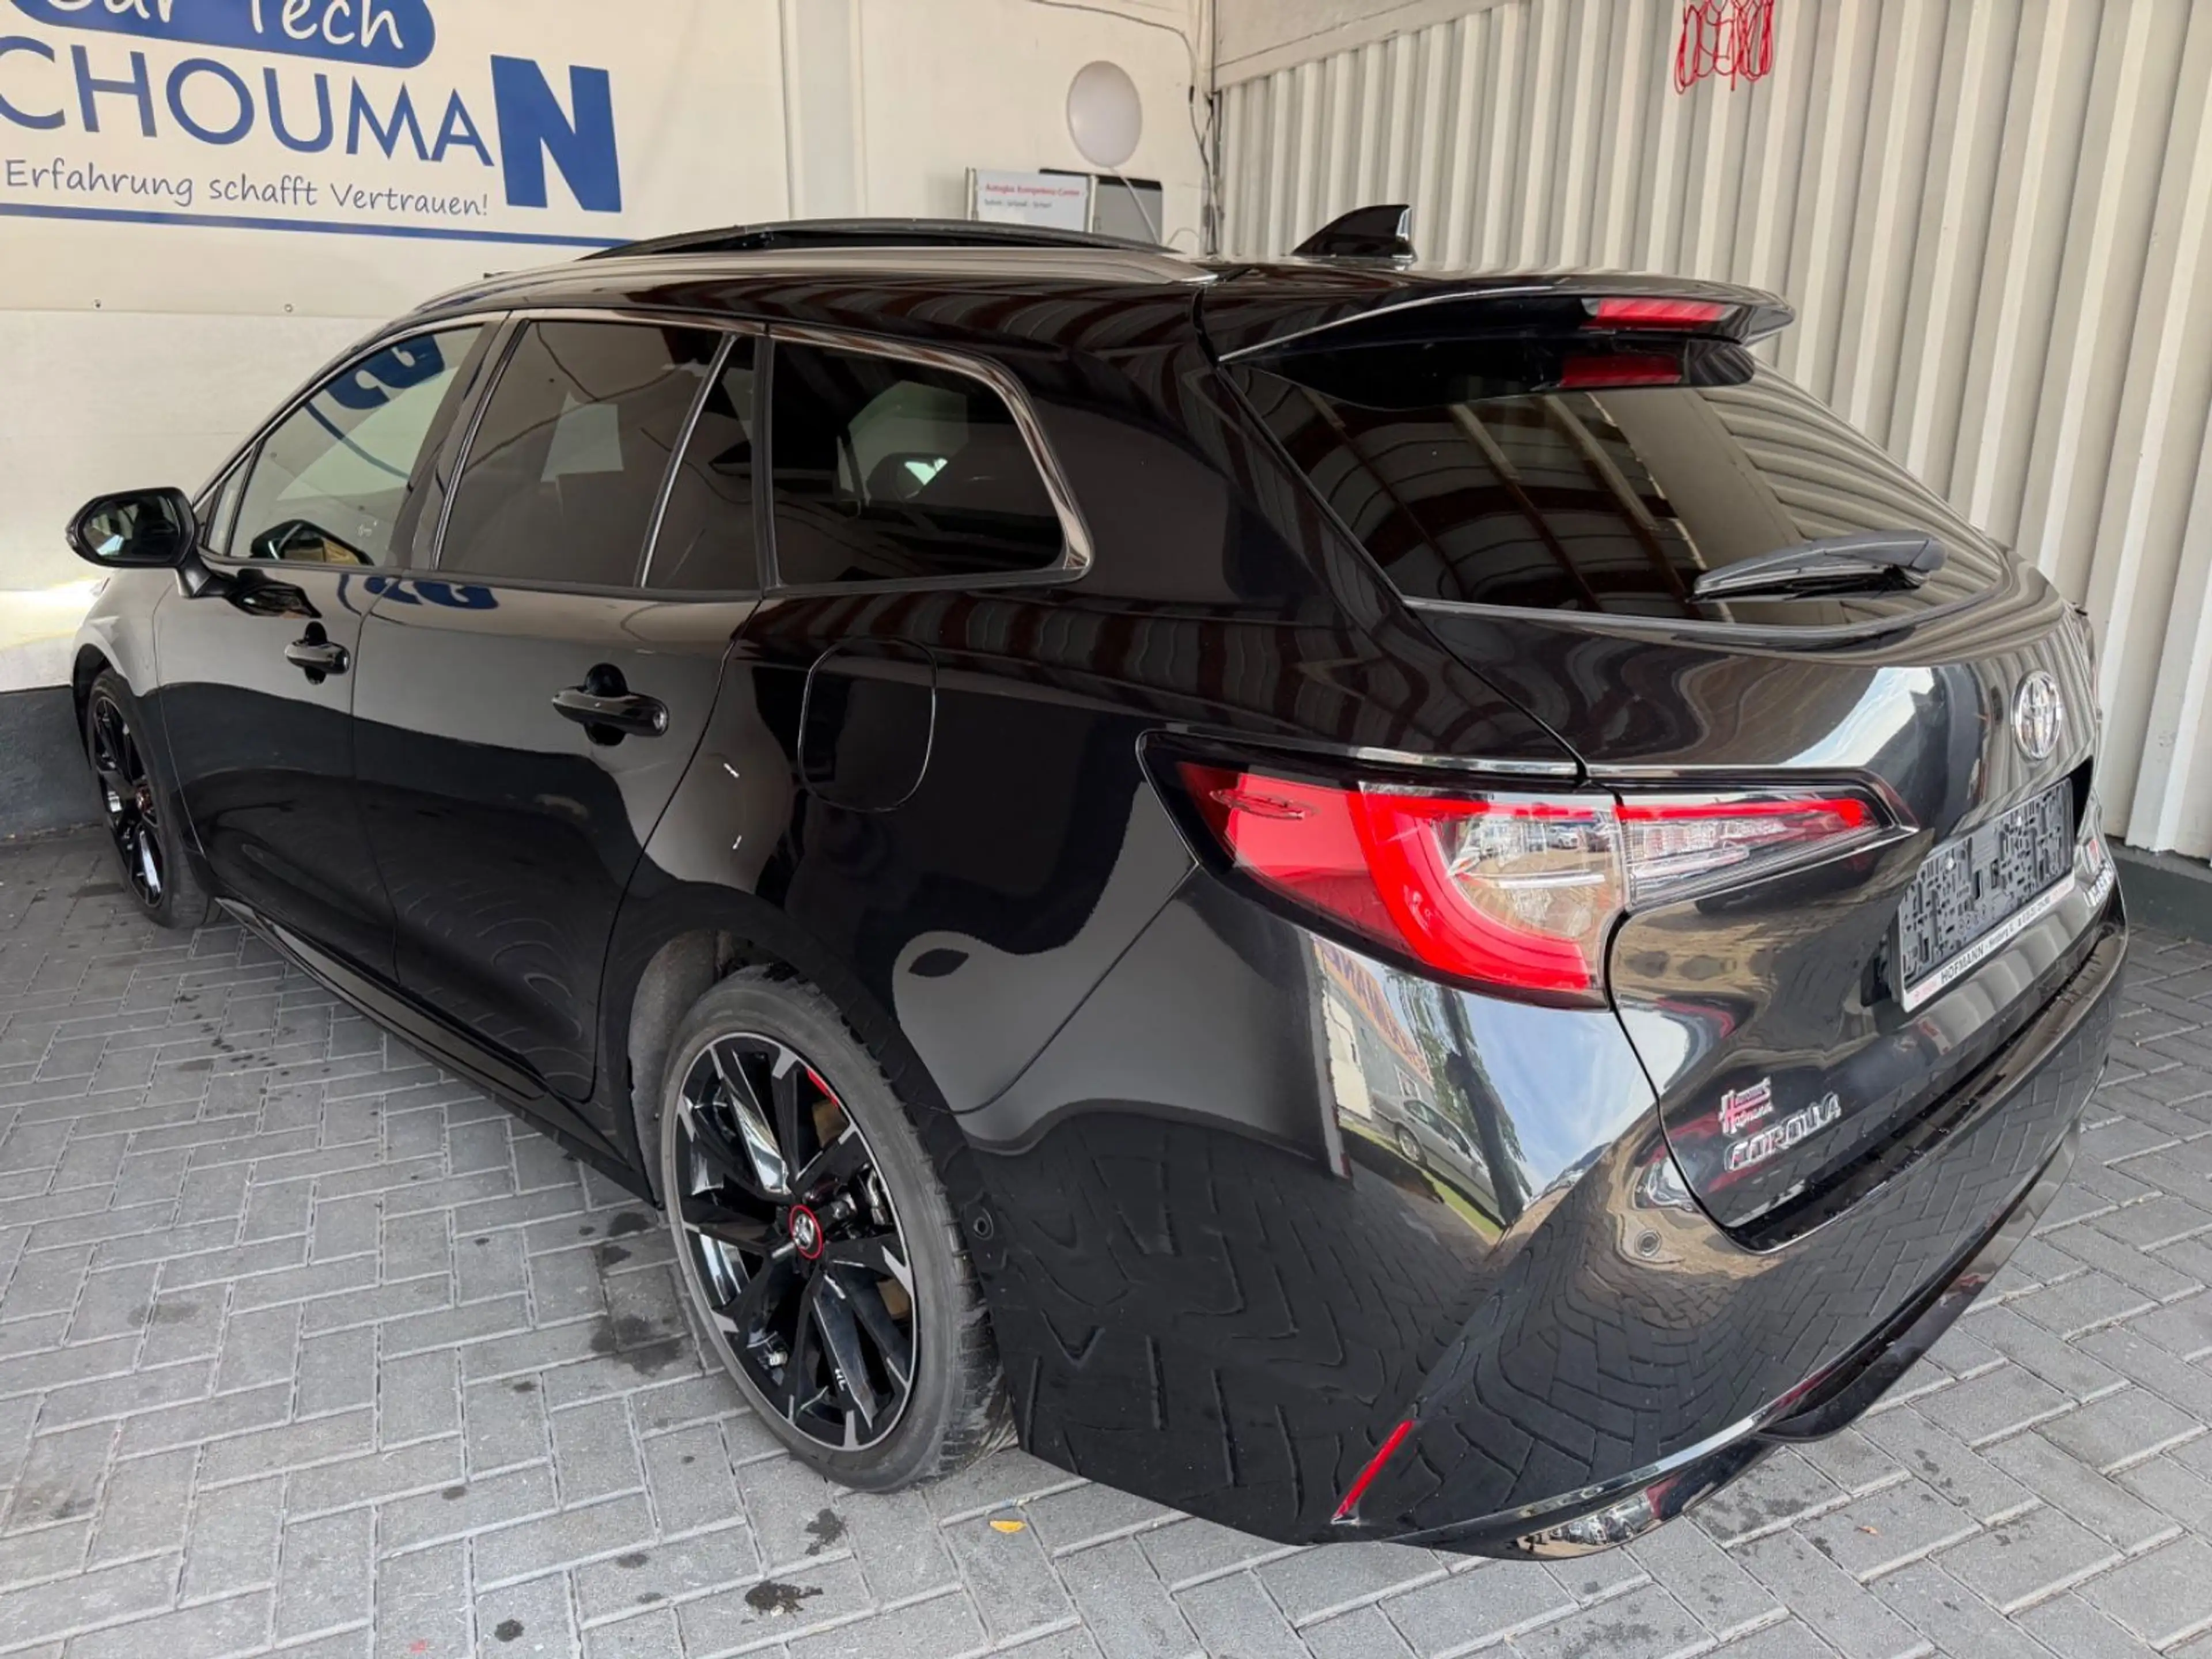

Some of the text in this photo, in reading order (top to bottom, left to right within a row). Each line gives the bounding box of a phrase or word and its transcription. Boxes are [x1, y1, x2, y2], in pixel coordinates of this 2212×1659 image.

[6, 157, 488, 216] Erfahrung schafft Vertrauen!
[1726, 1093, 1842, 1171] COROLLA
